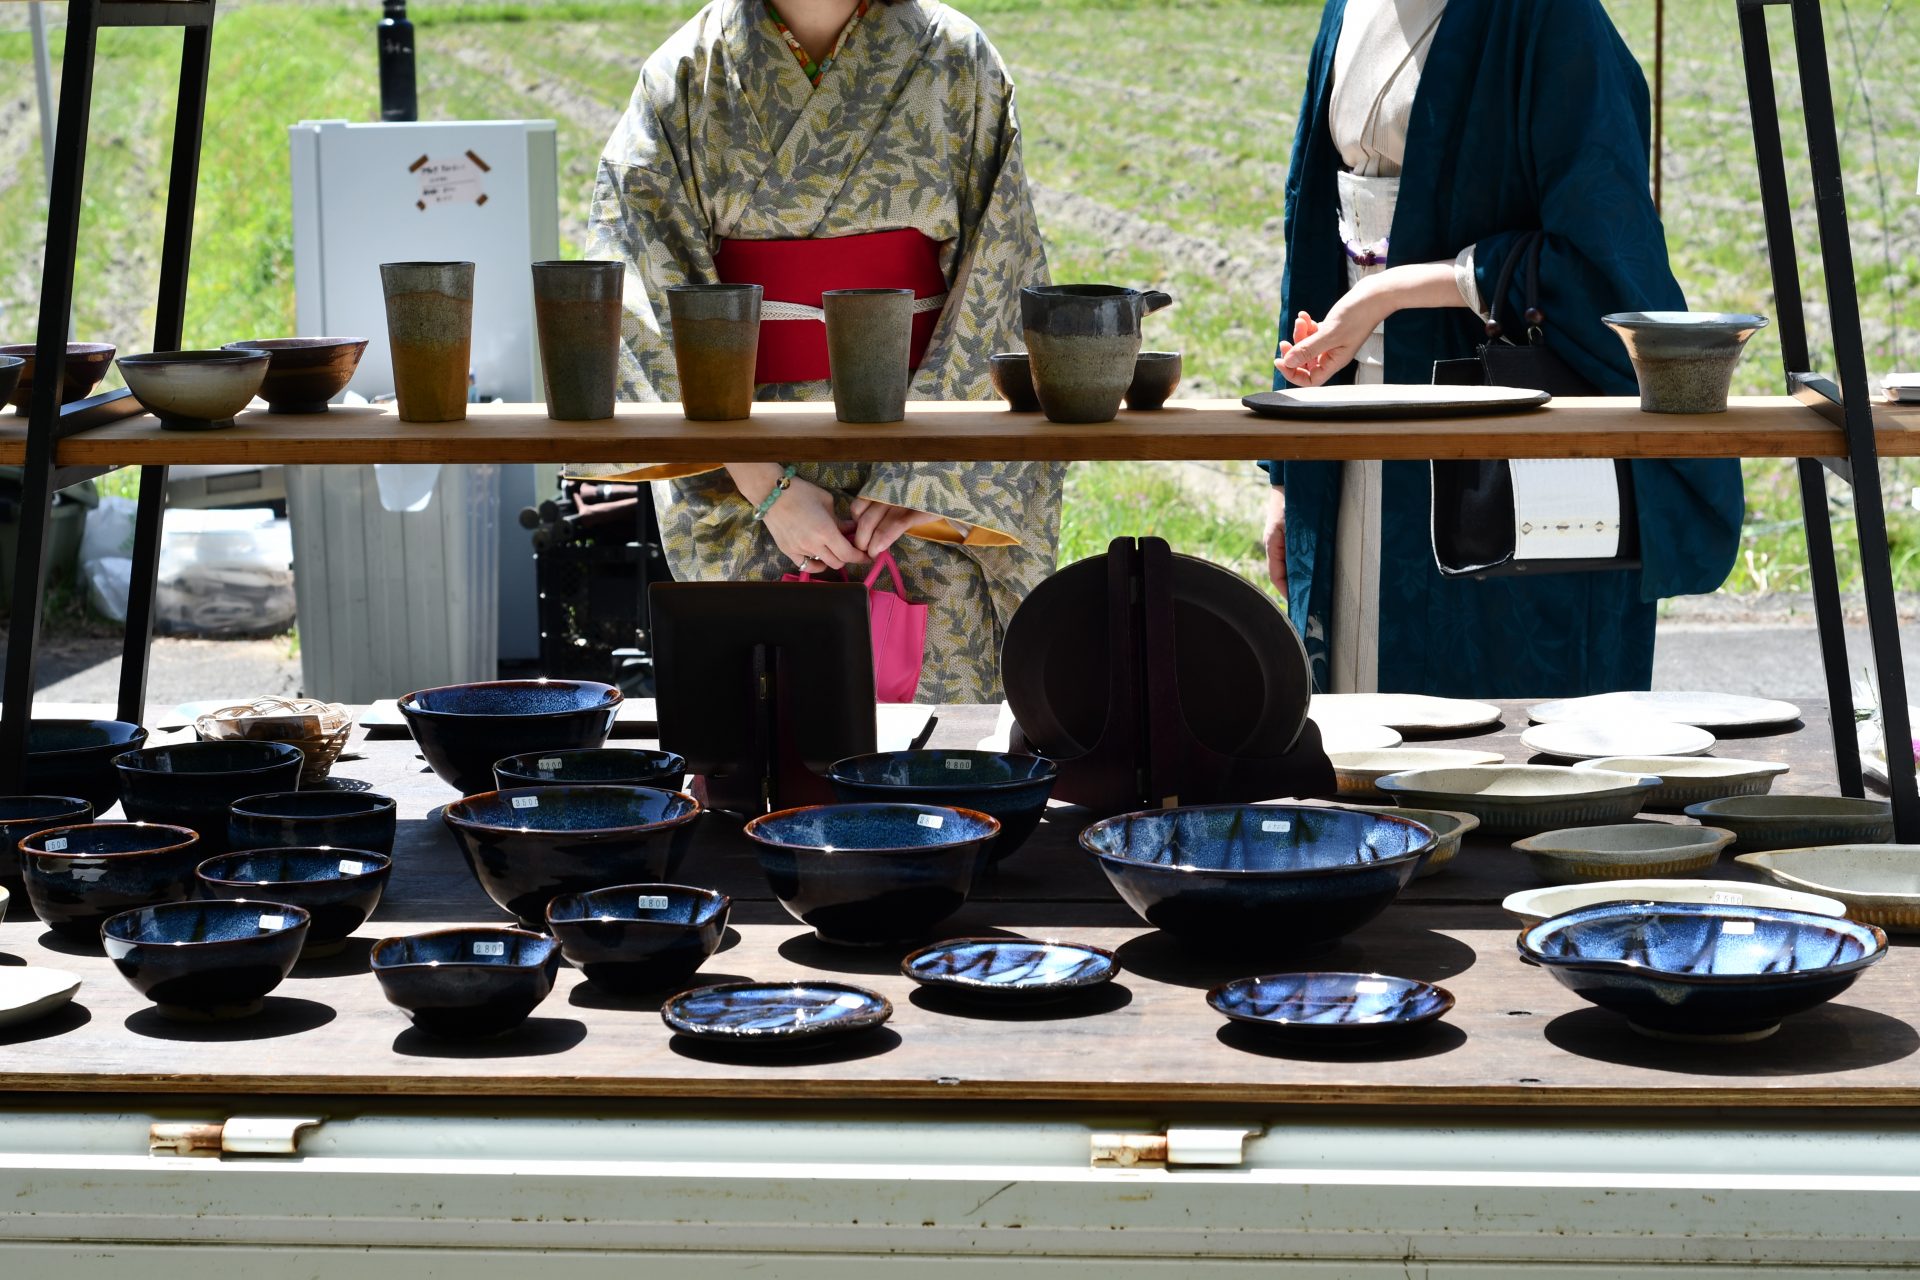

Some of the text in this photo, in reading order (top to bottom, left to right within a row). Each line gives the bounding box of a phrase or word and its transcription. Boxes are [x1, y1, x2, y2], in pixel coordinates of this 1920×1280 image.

[946, 760, 970, 769] 2800
[640, 898, 667, 908] 2800
[1714, 894, 1741, 904] 3500
[476, 944, 502, 954] 2800
